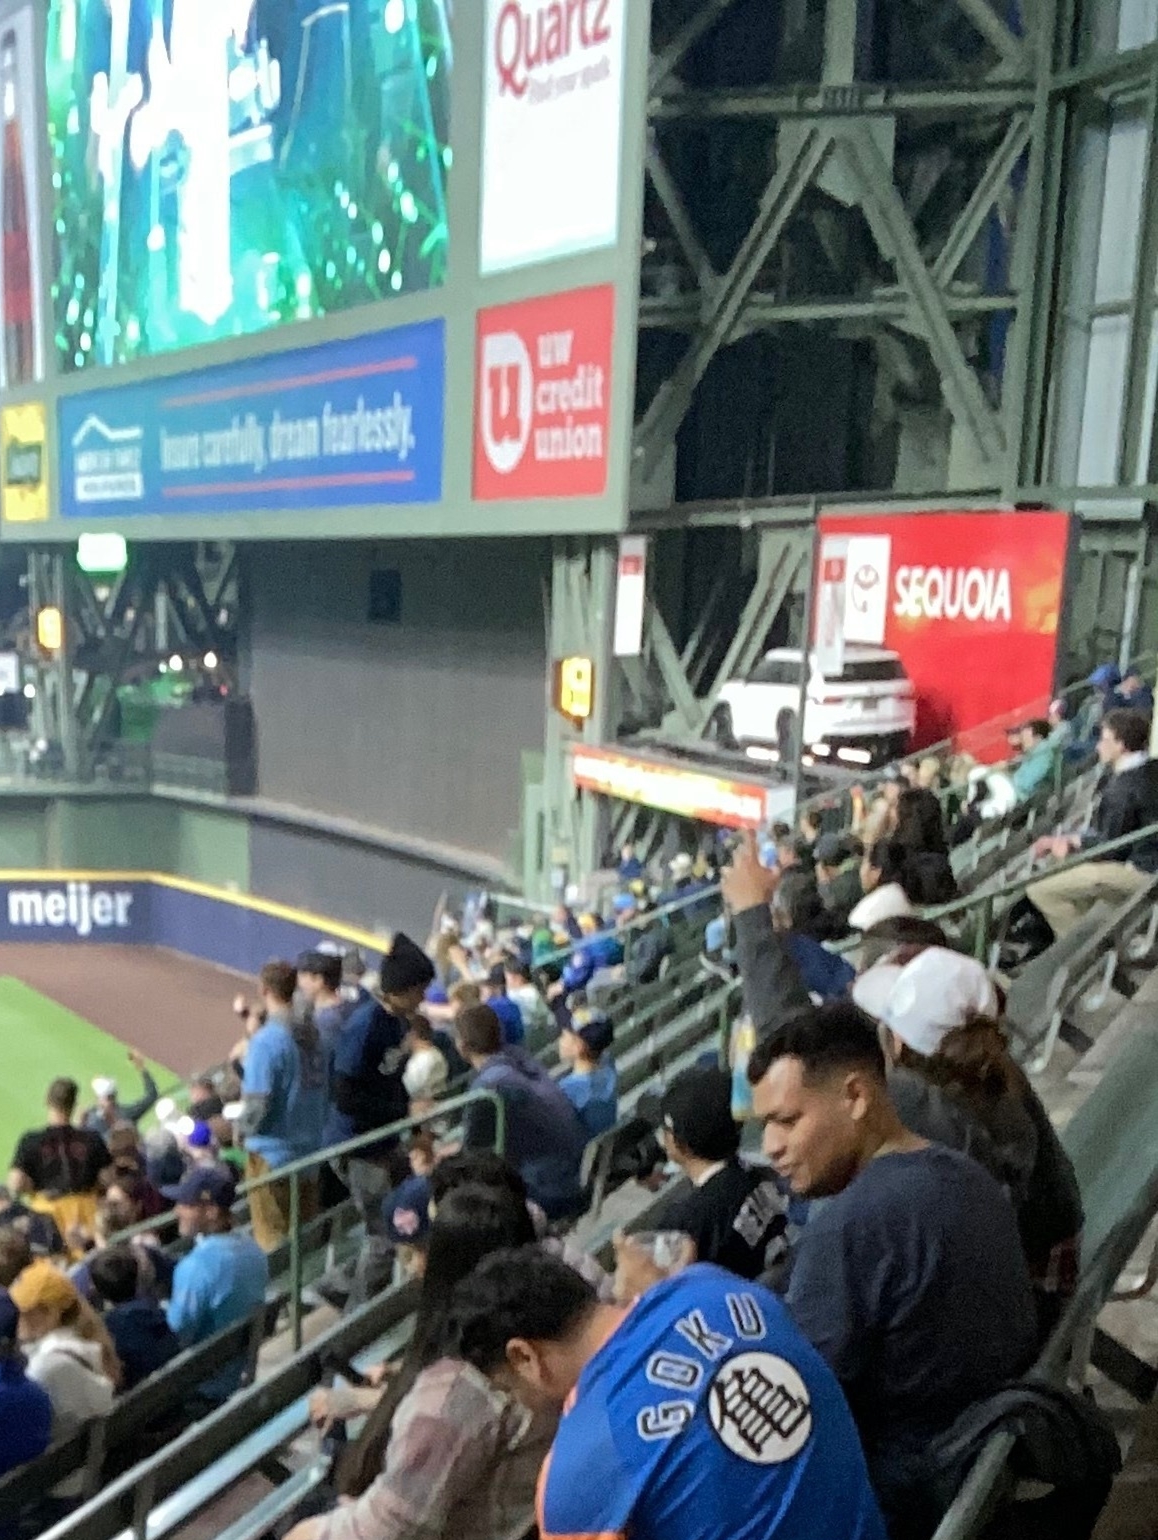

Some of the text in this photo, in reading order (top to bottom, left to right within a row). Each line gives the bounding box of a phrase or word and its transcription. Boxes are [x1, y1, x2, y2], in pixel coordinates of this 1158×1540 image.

[495, 0, 611, 98] Quartz
[536, 362, 604, 415] credit
[534, 414, 603, 461] union
[893, 564, 1012, 623] SEQUOIA
[7, 881, 134, 936] meijer
[636, 1292, 766, 1442] GOKU
